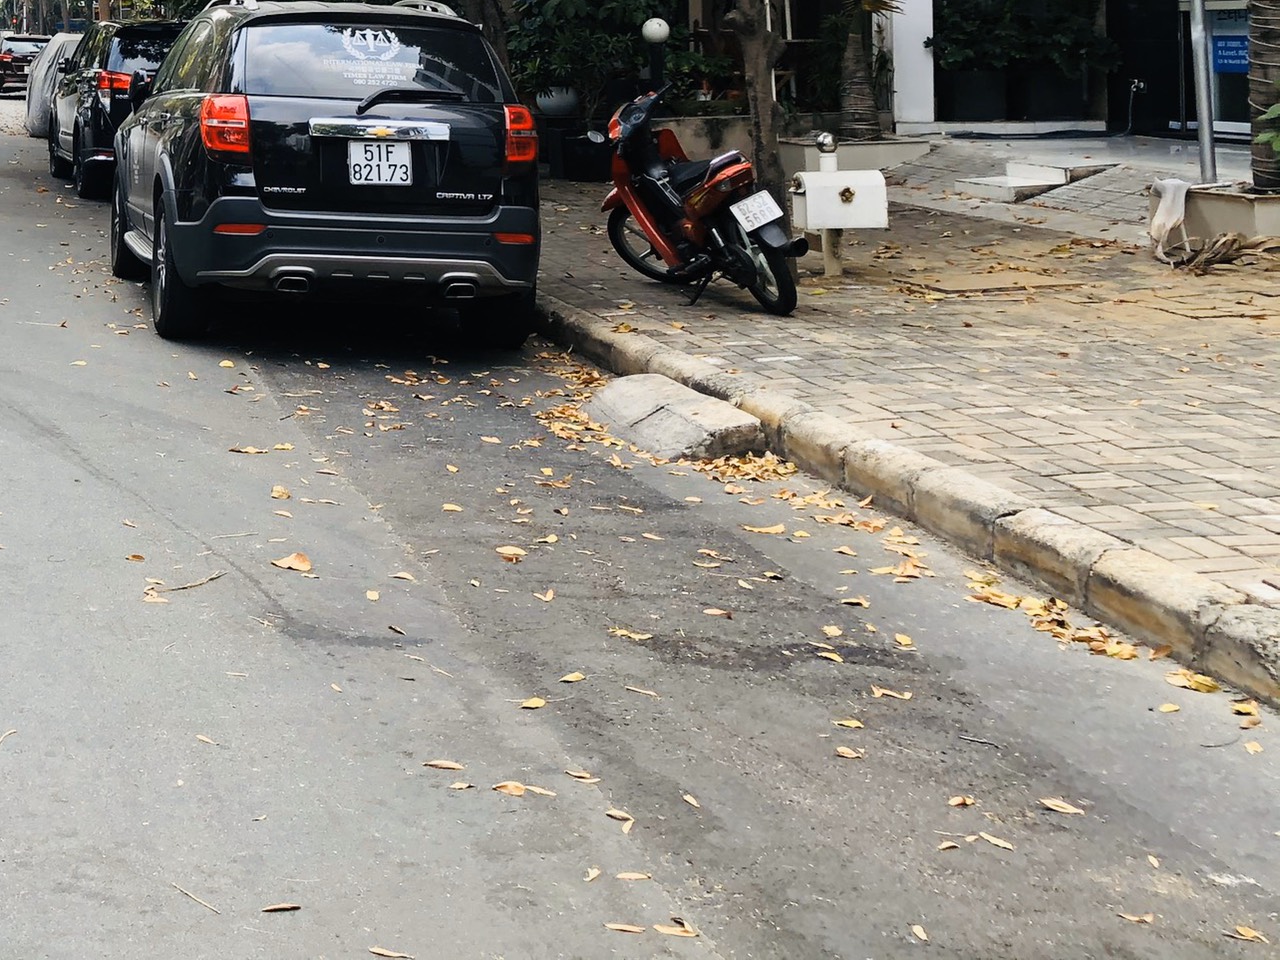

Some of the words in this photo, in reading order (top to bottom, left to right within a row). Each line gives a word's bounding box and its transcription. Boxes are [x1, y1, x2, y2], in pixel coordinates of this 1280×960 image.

[363, 144, 395, 162] 51F
[352, 163, 409, 182] 821.73
[436, 191, 474, 200] CAPTIVA
